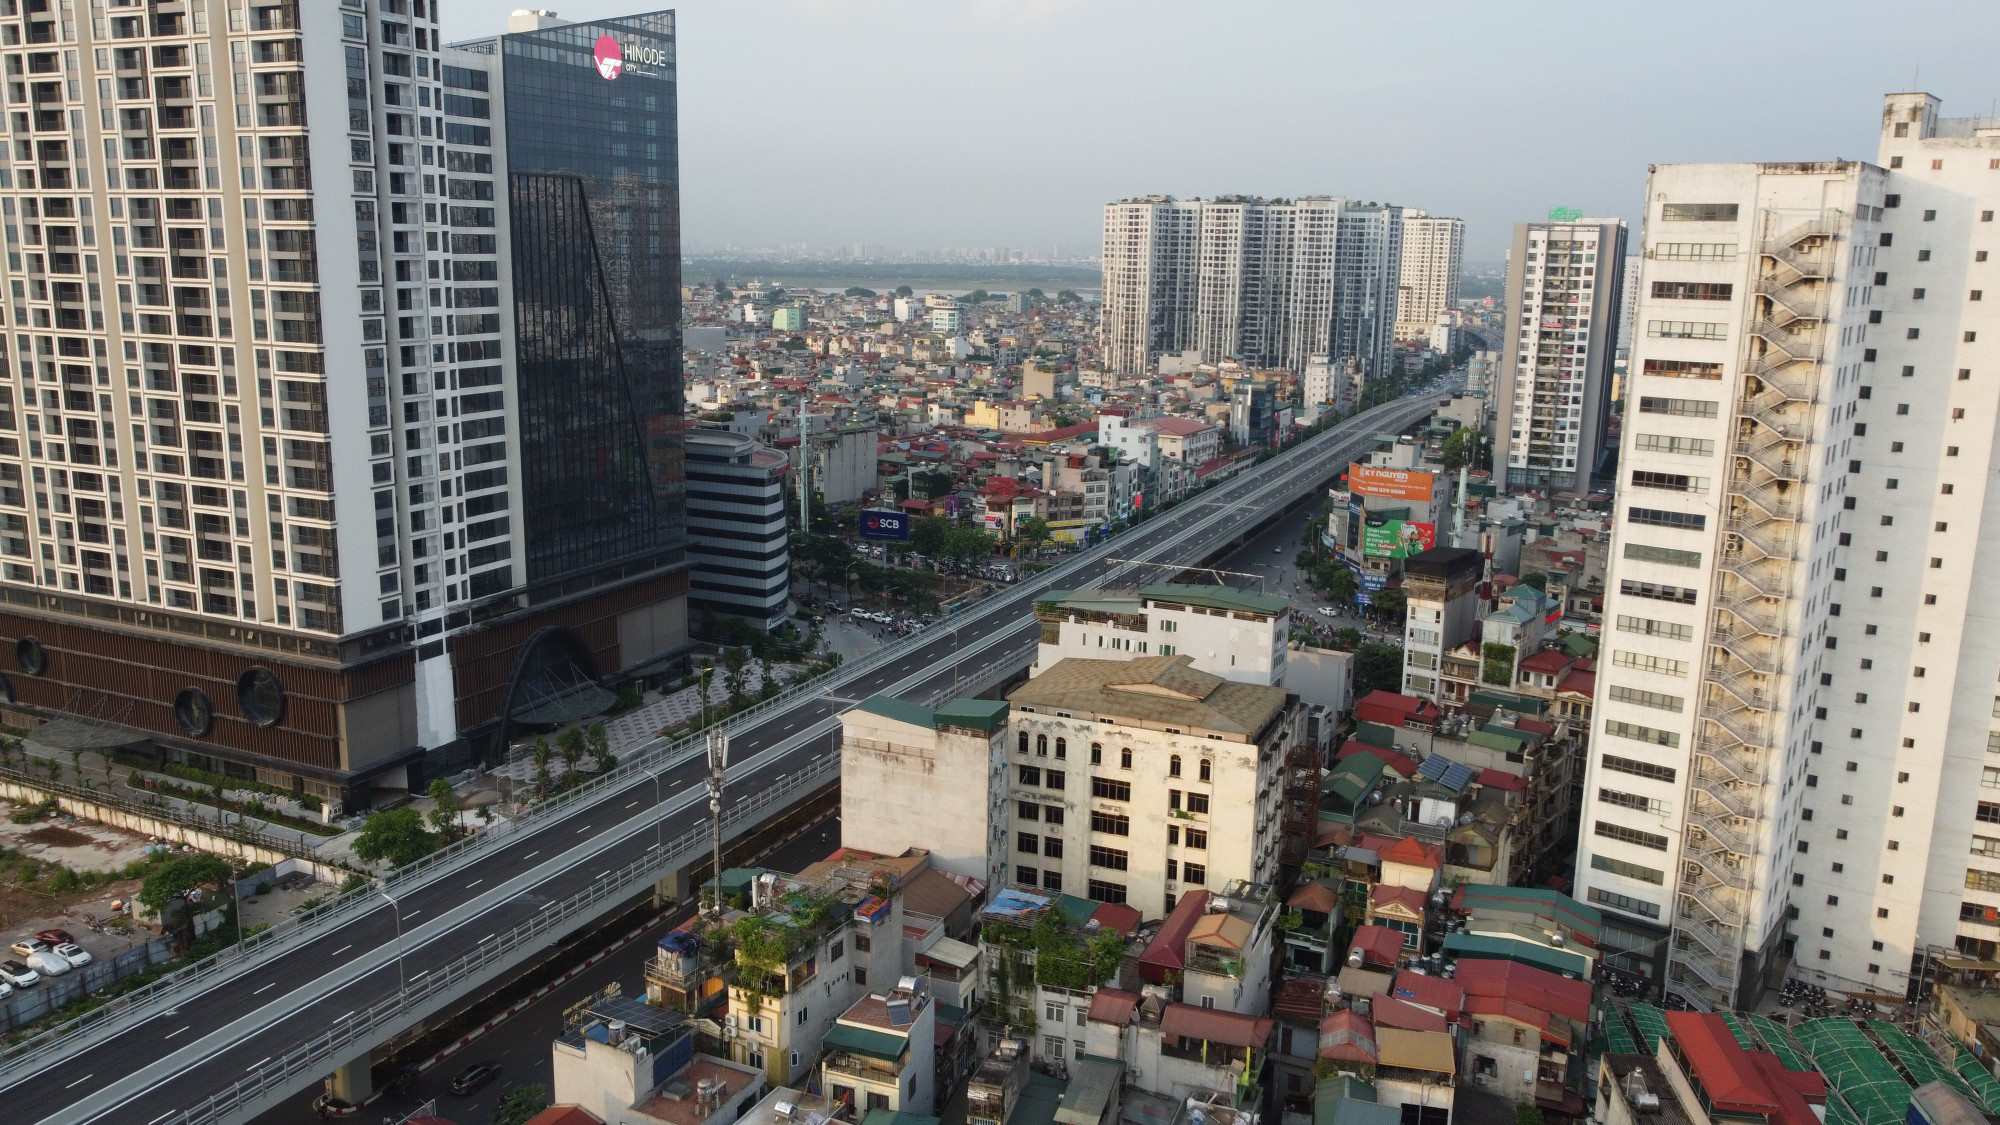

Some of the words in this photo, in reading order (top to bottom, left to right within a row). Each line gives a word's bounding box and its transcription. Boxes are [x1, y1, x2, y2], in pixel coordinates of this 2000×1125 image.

[624, 44, 666, 66] HINODE
[626, 64, 636, 72] CITY
[880, 519, 899, 528] SCB
